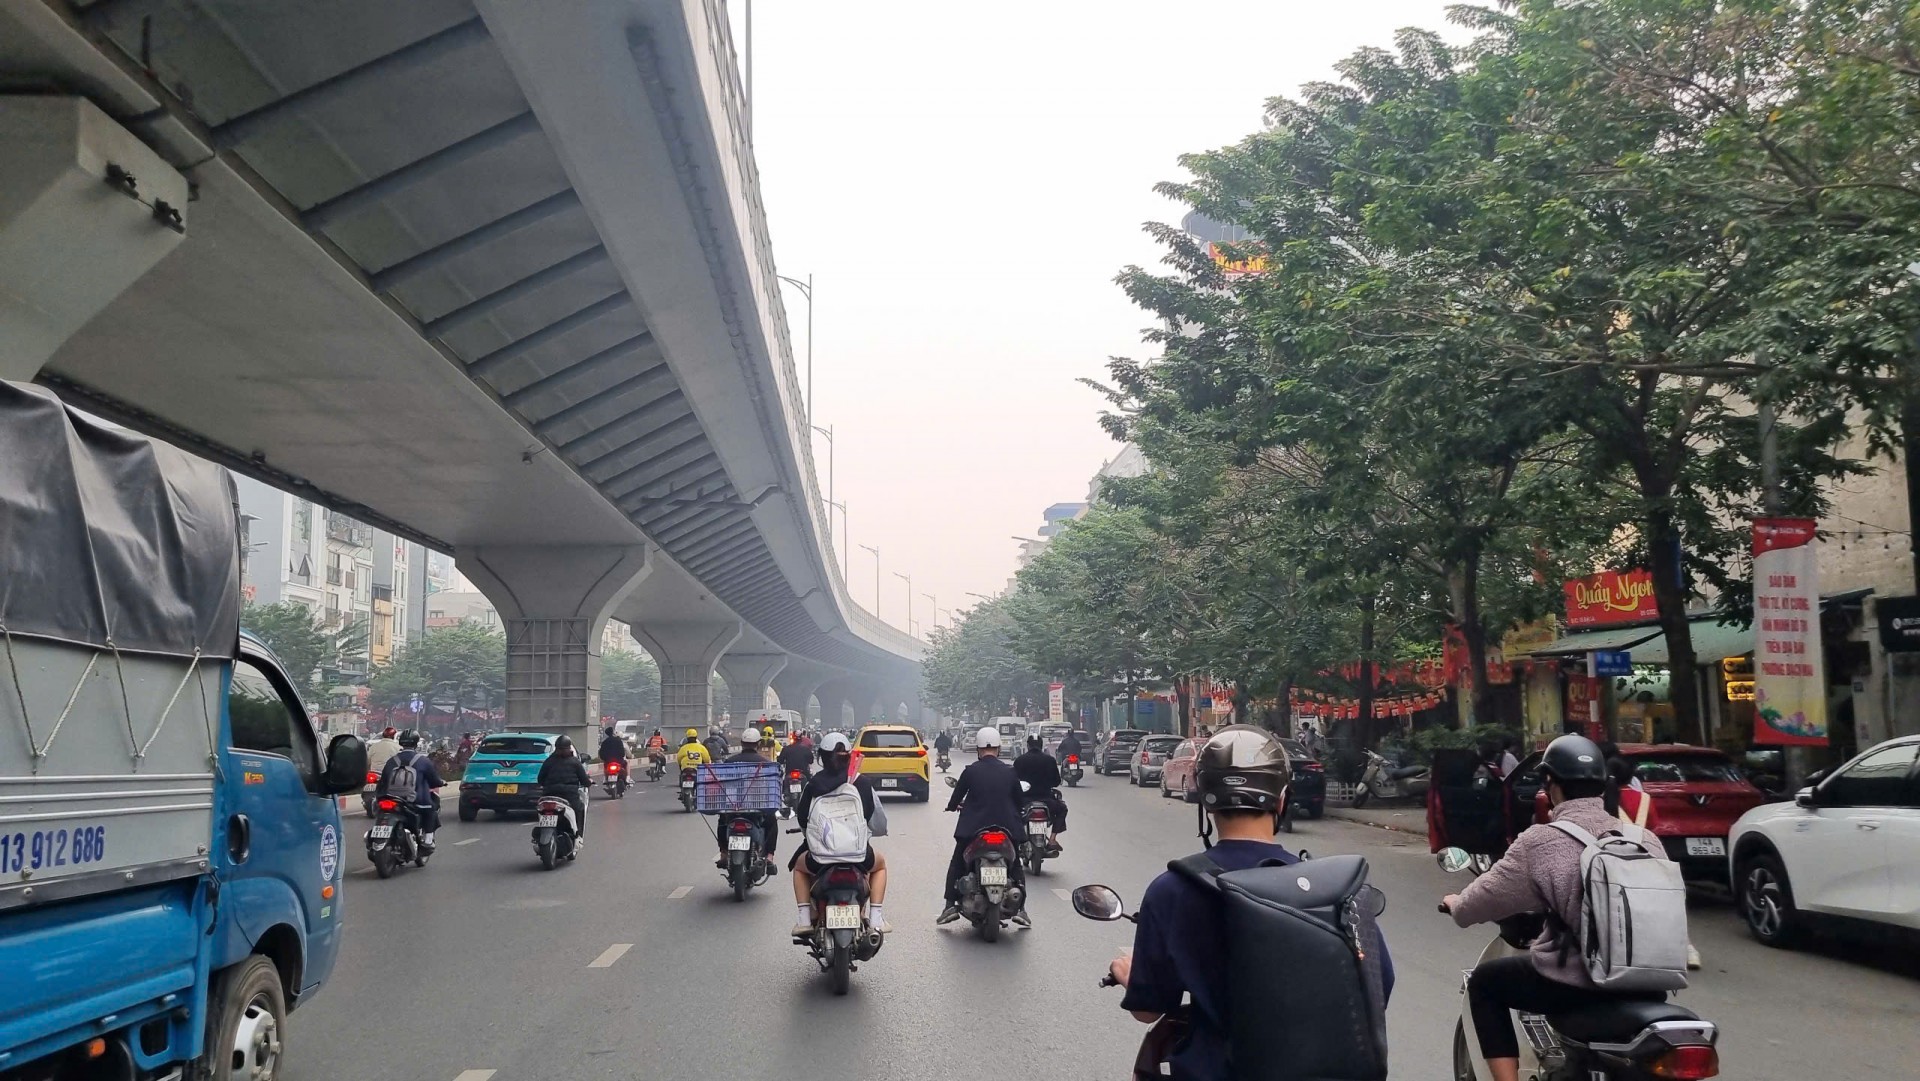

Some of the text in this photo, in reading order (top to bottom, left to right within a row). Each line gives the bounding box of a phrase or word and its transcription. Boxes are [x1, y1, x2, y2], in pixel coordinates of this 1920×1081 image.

[1576, 576, 1611, 611] Quẩy
[687, 750, 700, 760] be
[31, 829, 68, 869] 912
[72, 825, 105, 864] 686
[833, 906, 854, 916] 19-P1
[828, 917, 858, 927] 066.83
